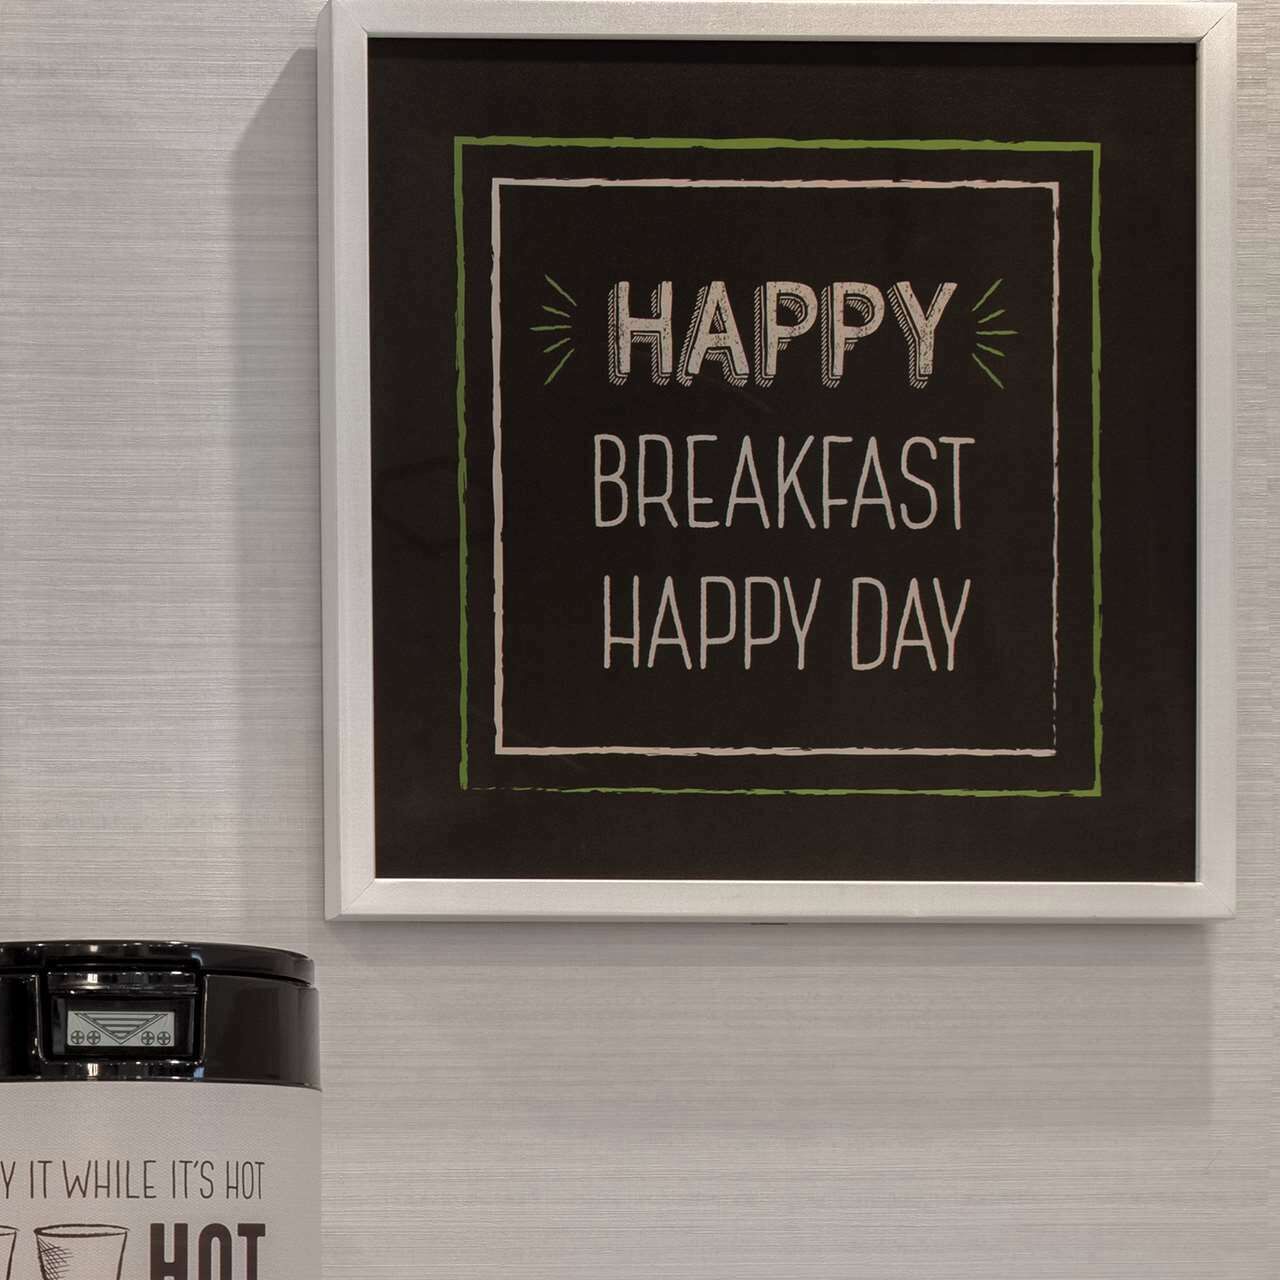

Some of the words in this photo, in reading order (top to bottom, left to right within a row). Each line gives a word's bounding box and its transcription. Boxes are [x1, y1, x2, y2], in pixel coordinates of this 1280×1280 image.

[607, 280, 957, 388] HAPPY
[593, 433, 975, 530] BREAKFAST
[603, 576, 821, 671] HAPPY
[850, 577, 971, 671] DAY
[30, 1160, 53, 1199] IT
[62, 1159, 157, 1199] WHILE
[172, 1161, 215, 1200] IT'S
[226, 1161, 266, 1200] HOT
